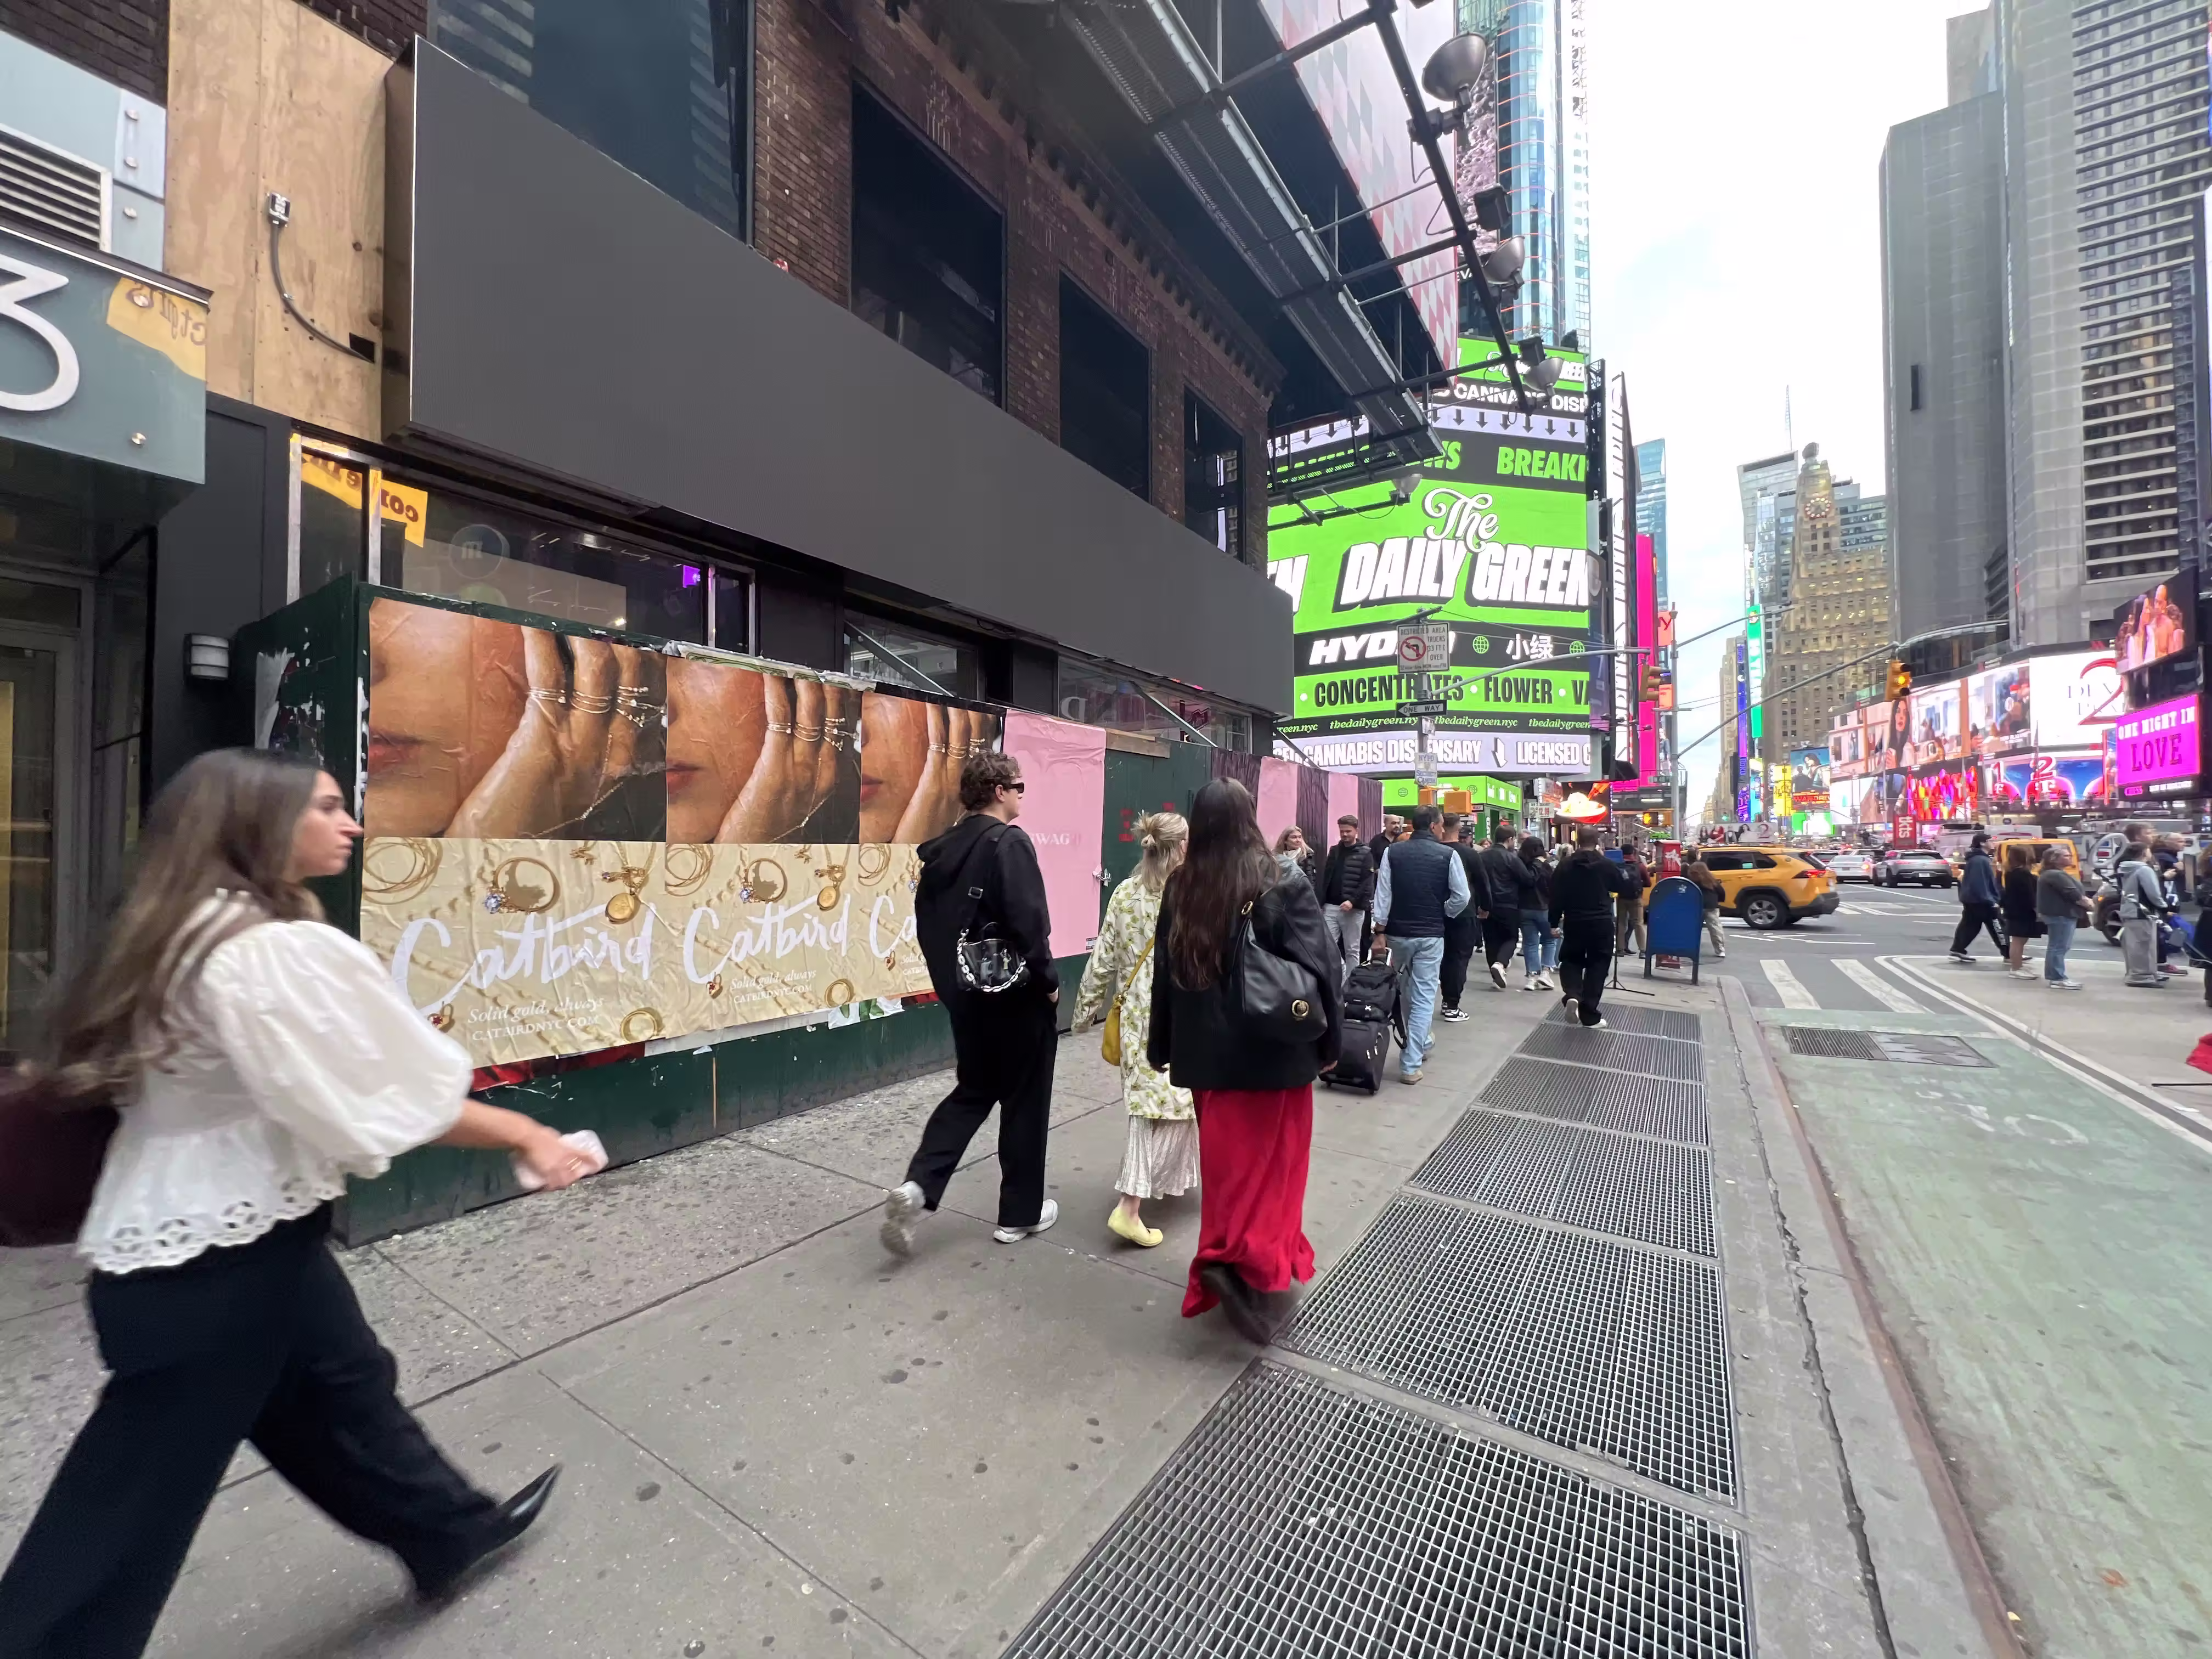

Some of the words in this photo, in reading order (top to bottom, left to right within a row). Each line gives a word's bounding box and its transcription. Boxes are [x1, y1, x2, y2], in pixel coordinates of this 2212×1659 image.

[1454, 382, 1547, 405] CANNA
[1423, 488, 1499, 554] The
[1340, 537, 1469, 605] DAILY
[1505, 634, 1555, 660] 小绿
[1483, 675, 1553, 704] FLOWER
[1329, 716, 1418, 730] thedailygreen.ny
[1434, 715, 1519, 729] thedailygreen.nyc
[2118, 721, 2138, 740] ONE
[2141, 710, 2177, 735] NIGHT
[2181, 706, 2196, 725] IN
[1302, 740, 1384, 767] CANNABIS
[1387, 738, 1482, 764] DISENSARY
[1516, 741, 1581, 765] LICENSED
[1418, 754, 1435, 762] NYPD
[2130, 732, 2183, 772] LOVE
[1898, 816, 1913, 838] tkts
[682, 893, 851, 984] Catbird
[391, 902, 656, 1014] Catbird
[731, 974, 757, 990] Solid
[784, 969, 817, 982] always
[468, 1005, 510, 1023] Solid
